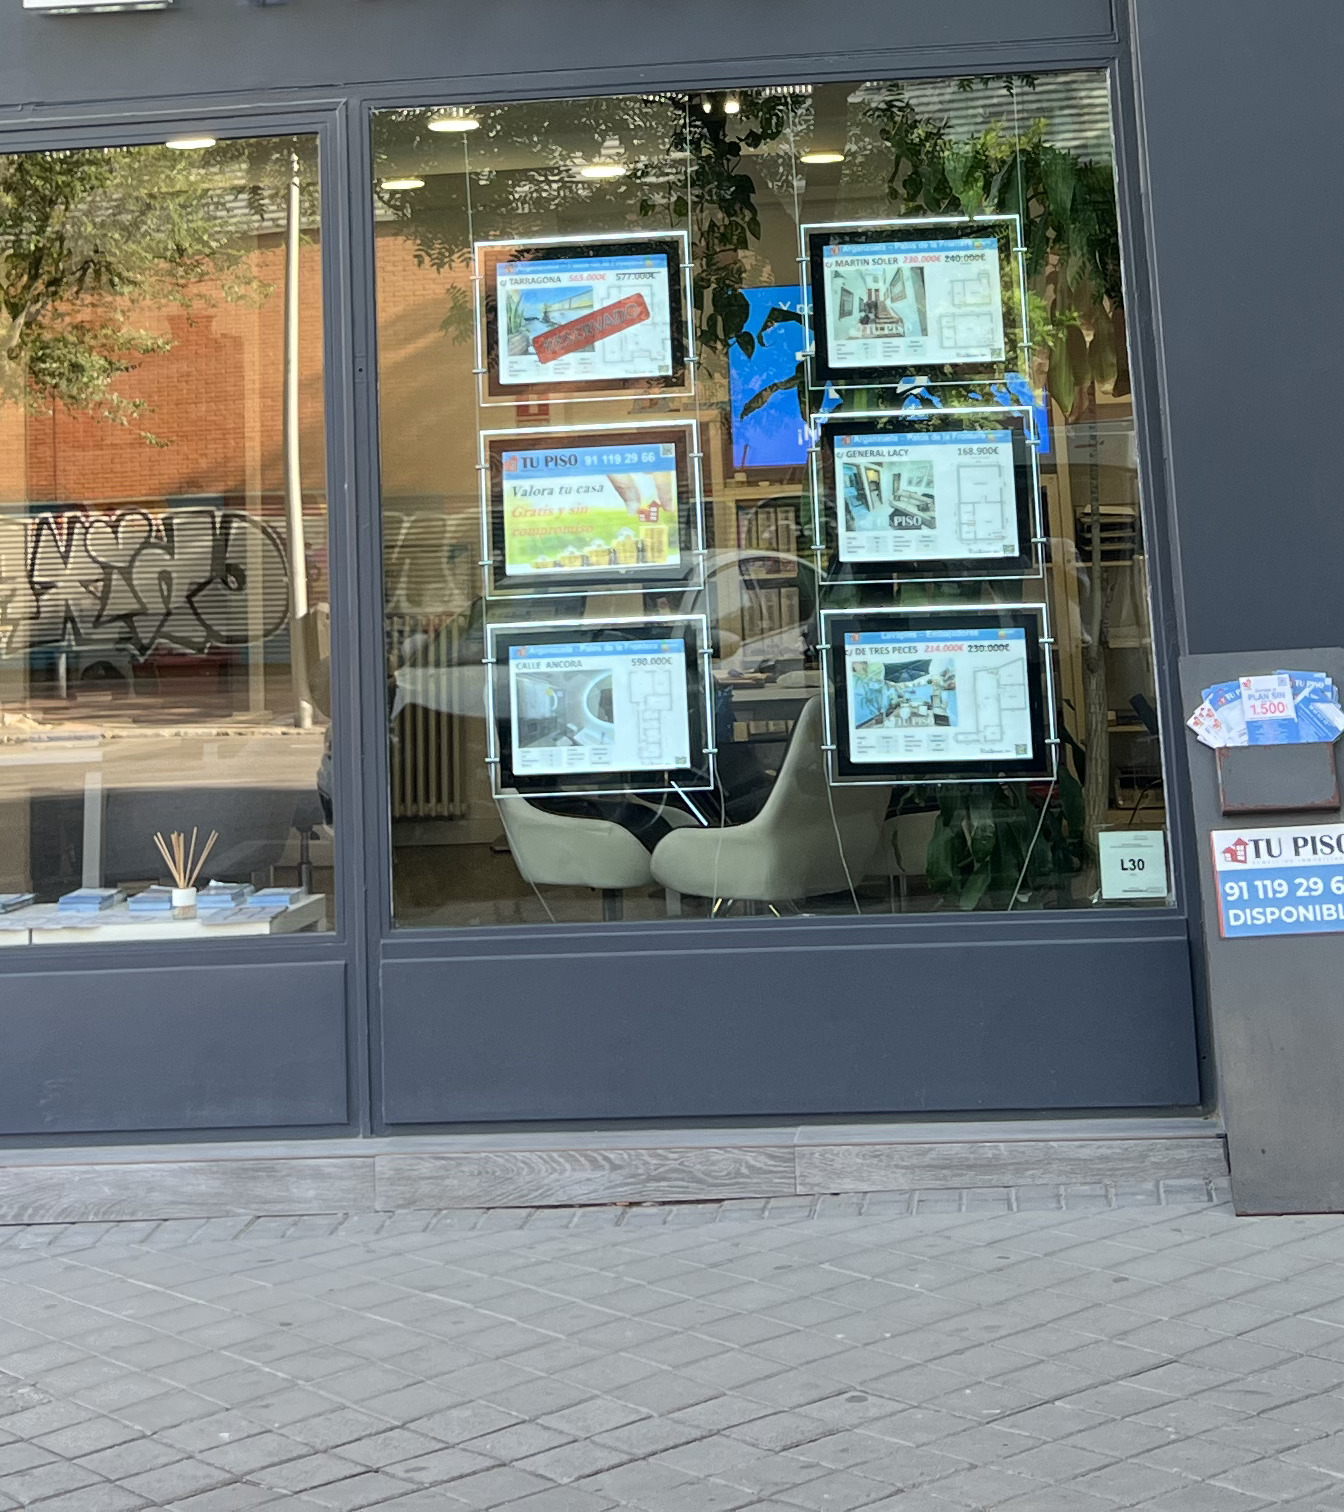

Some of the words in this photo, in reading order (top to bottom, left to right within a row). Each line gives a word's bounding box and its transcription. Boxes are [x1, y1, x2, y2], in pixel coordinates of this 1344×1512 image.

[835, 259, 870, 268] MARTIN
[871, 257, 899, 266] SOLER
[509, 275, 562, 286] TARRAGONA
[846, 449, 886, 459] GENERAL
[887, 448, 909, 458] LACY
[957, 446, 1000, 456] 168.900€
[521, 456, 539, 469] TU
[545, 453, 578, 468] PISO
[602, 454, 622, 465] 119
[624, 453, 638, 465] 29
[641, 451, 656, 463] 66
[512, 485, 554, 498] Valora
[558, 485, 572, 495] tu
[576, 483, 604, 494] casa
[511, 504, 553, 519] Gratis
[554, 507, 566, 520] y
[569, 502, 589, 515] sin
[894, 515, 922, 527] PISO
[511, 524, 594, 539] compromiso
[855, 647, 866, 656] DE
[869, 646, 890, 655] TRES
[892, 645, 918, 654] PECES
[515, 661, 542, 671] CALLE
[546, 659, 583, 669] ANCORA
[1248, 837, 1283, 859] TU
[1120, 858, 1145, 871] L30
[1224, 881, 1249, 901] 91
[1253, 879, 1289, 899] 119
[1294, 877, 1324, 897] 29
